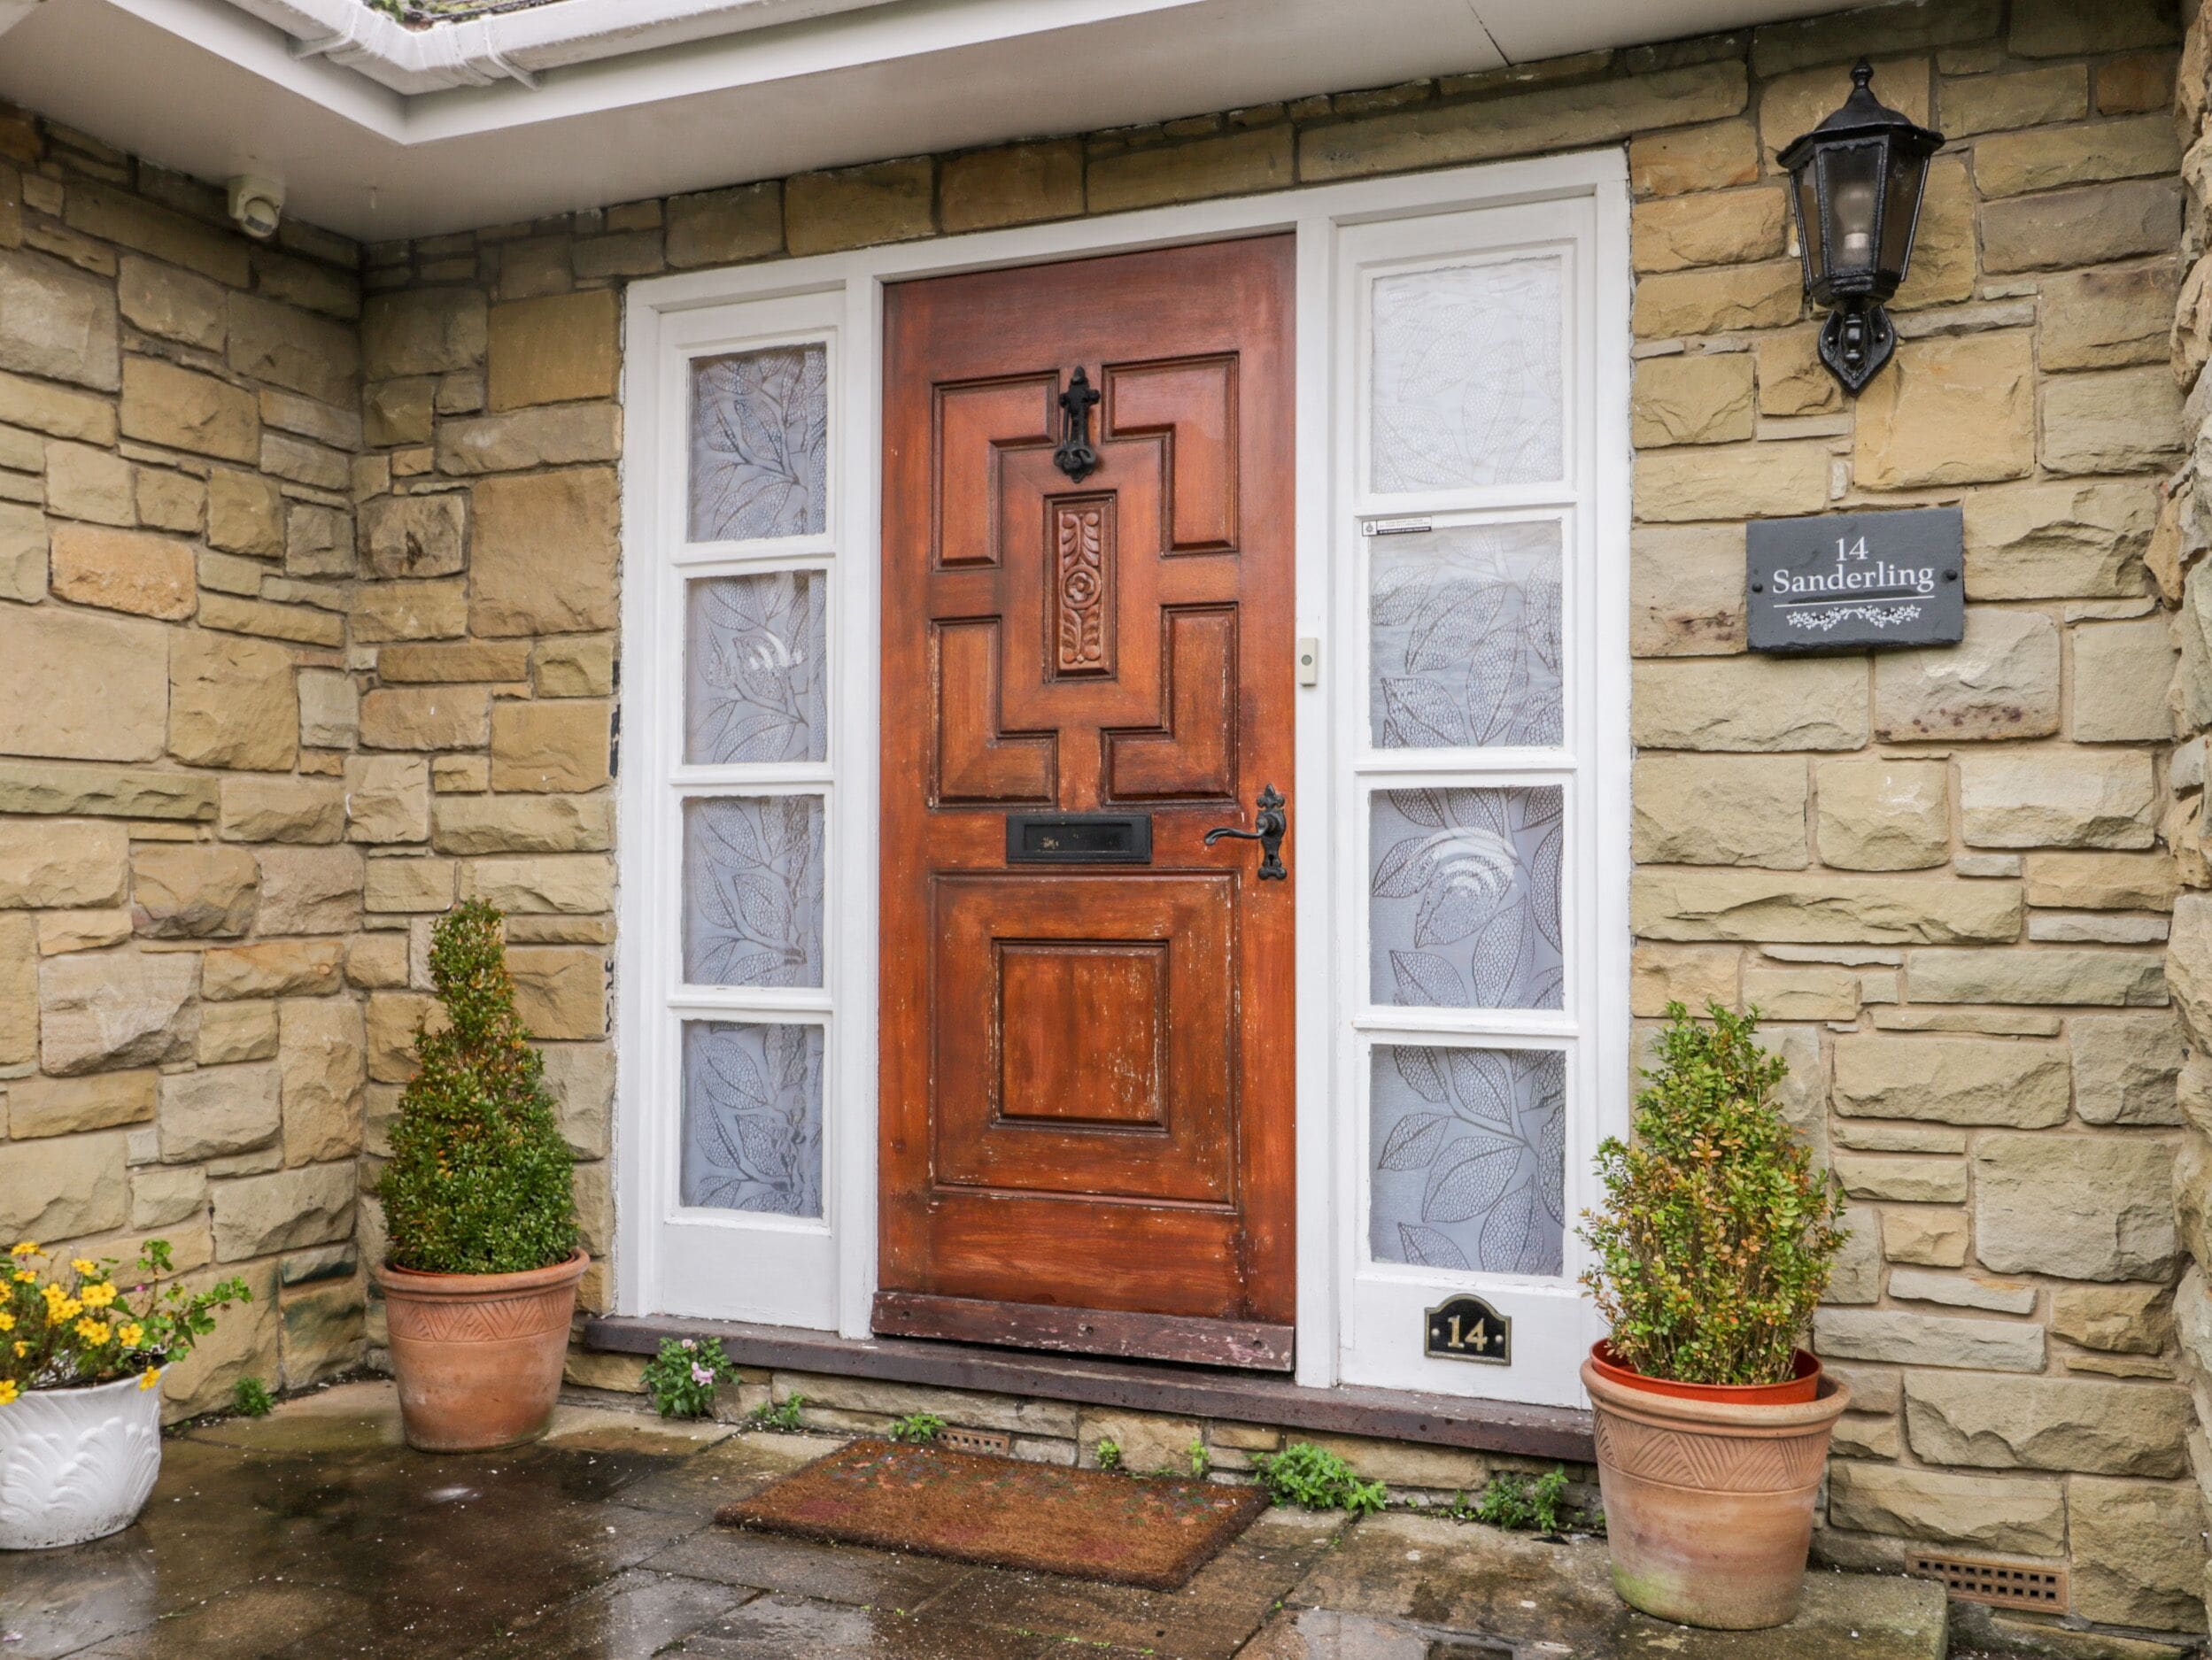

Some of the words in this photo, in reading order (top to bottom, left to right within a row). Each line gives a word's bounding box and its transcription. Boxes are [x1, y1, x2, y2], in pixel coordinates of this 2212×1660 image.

[1835, 536, 1869, 562] 14
[1772, 560, 1936, 594] Sanderling
[1447, 1314, 1489, 1352] 14
